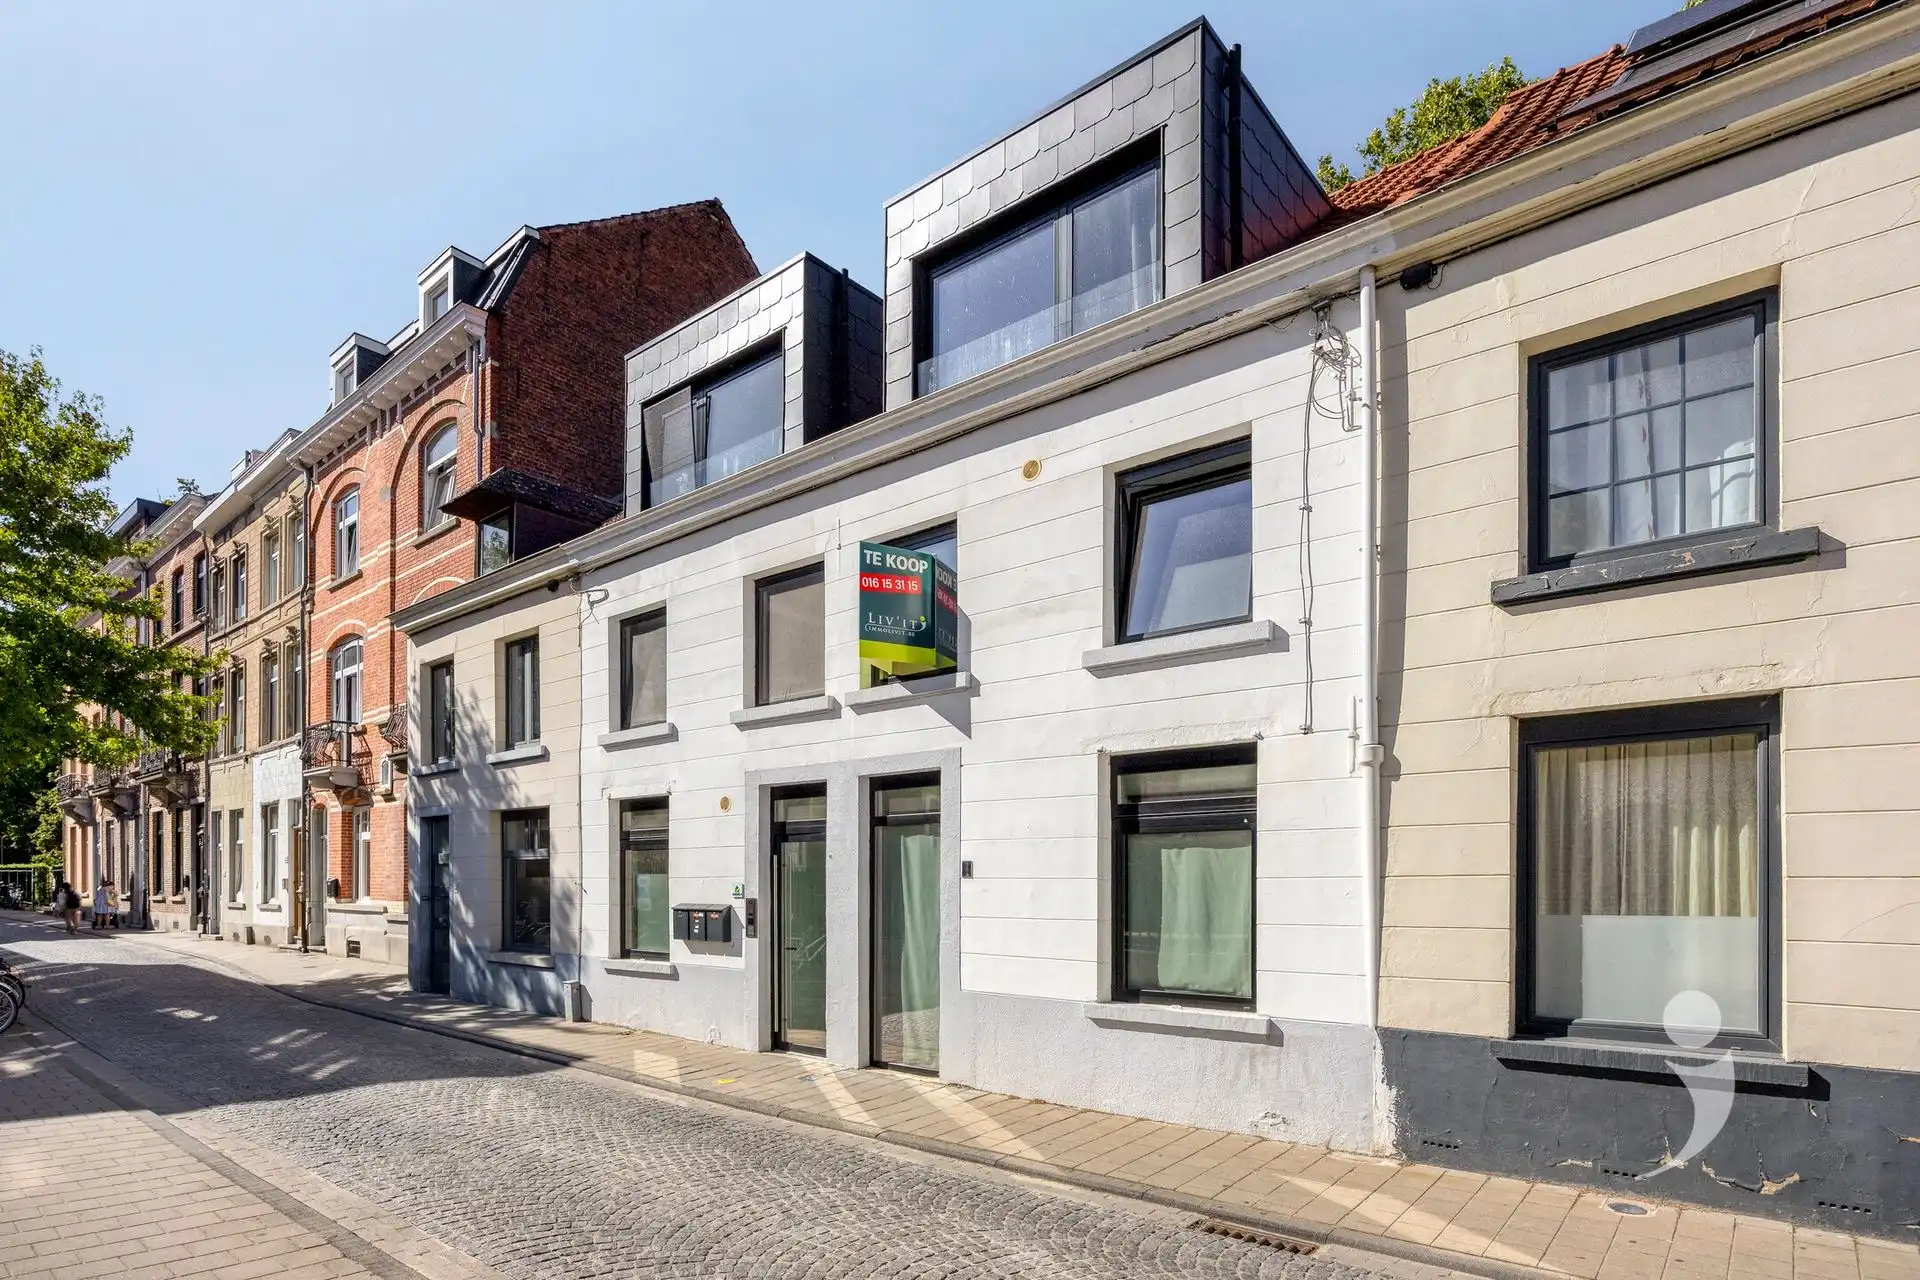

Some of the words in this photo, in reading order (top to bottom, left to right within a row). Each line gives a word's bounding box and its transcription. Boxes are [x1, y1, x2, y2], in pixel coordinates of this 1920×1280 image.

[864, 549, 882, 566] TE
[886, 553, 928, 574] KOOP
[862, 576, 880, 588] 016
[881, 578, 893, 589] 15
[895, 579, 905, 590] 31
[907, 580, 918, 591] 15
[868, 612, 918, 630] LIV'IT
